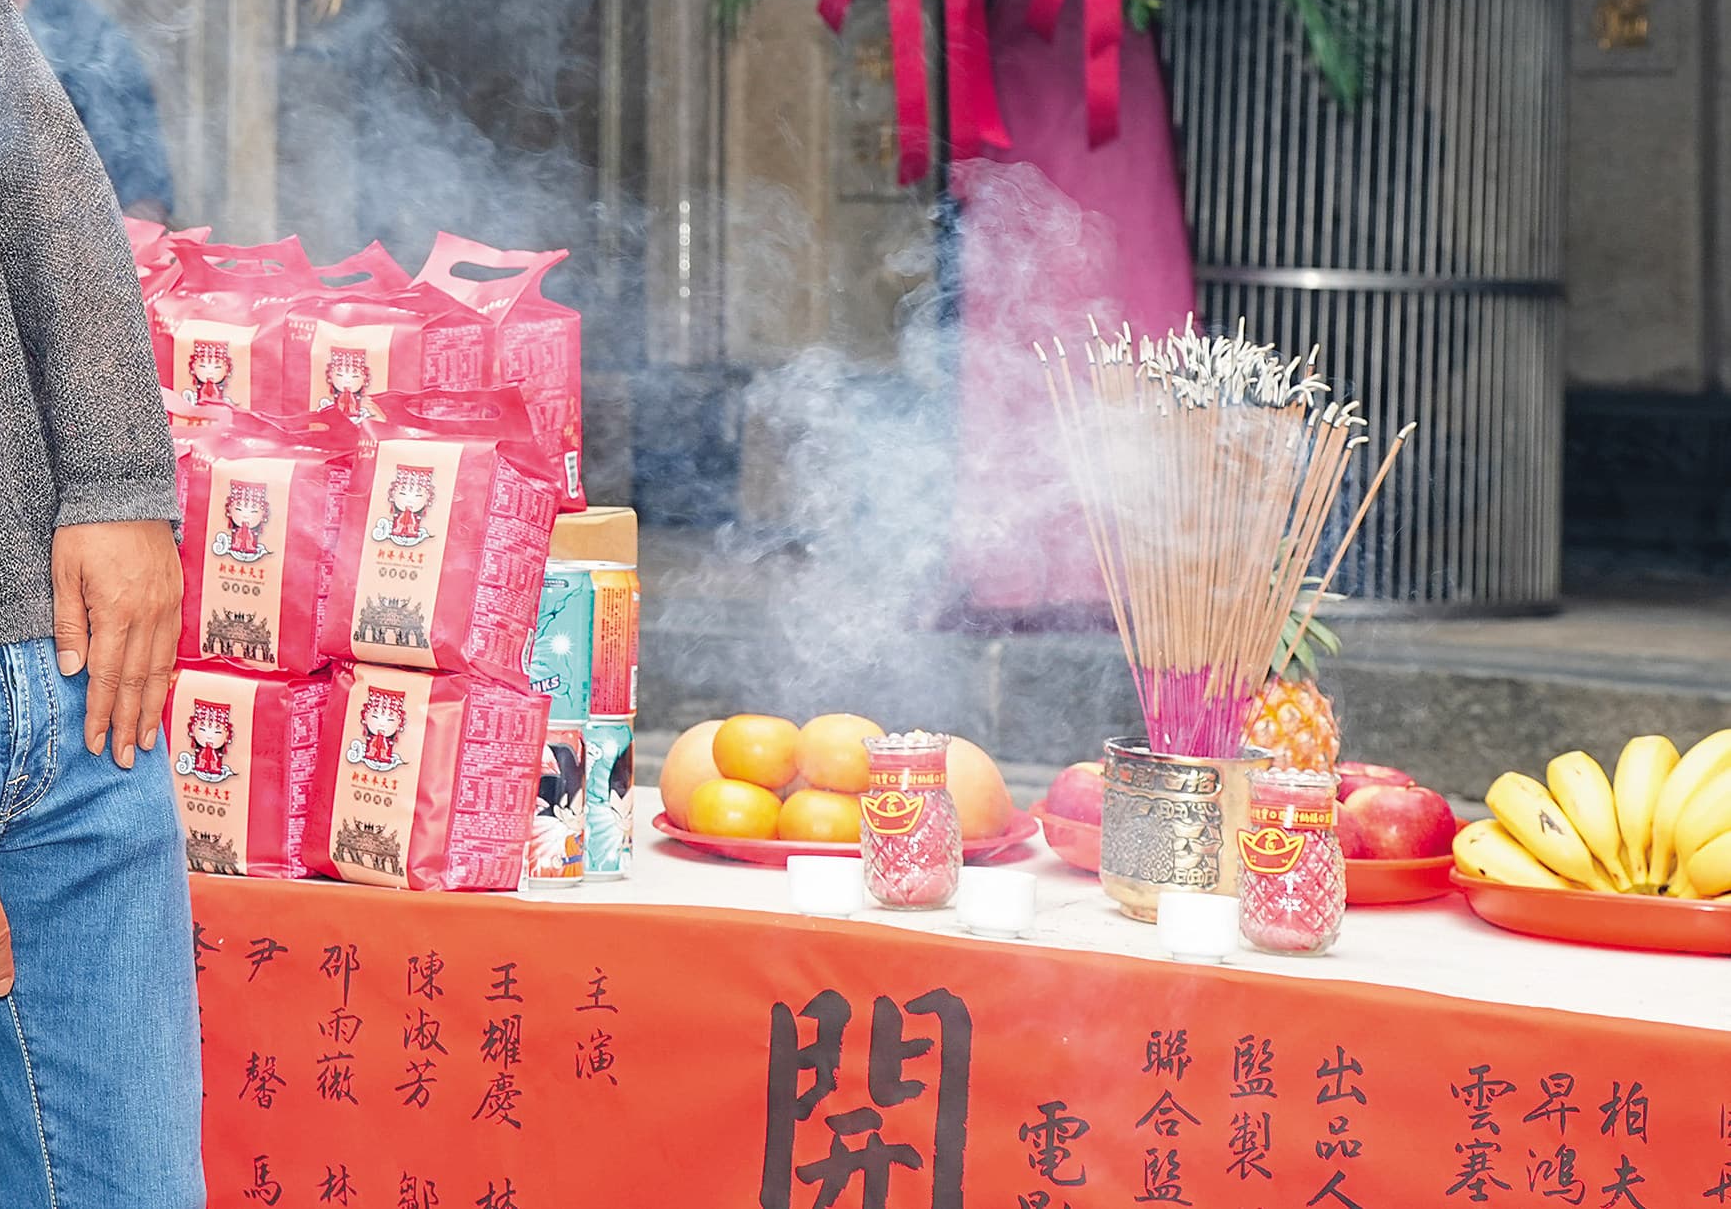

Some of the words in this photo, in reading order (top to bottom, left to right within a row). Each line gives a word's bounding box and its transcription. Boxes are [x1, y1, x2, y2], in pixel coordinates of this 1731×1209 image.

[238, 937, 288, 1109] 尹馨
[316, 943, 364, 1105] 邵雨薇
[395, 949, 450, 1109] 陳淑芳
[471, 962, 525, 1130] 王耀慶
[574, 966, 619, 1086] 主演
[759, 988, 974, 1209] 開
[243, 1154, 283, 1206] 馬
[318, 1164, 358, 1207] 林
[1134, 1029, 1203, 1207] 聯合監
[1225, 1034, 1278, 1181] 監製
[1306, 1045, 1368, 1209] 出品人
[1598, 1080, 1650, 1209] 柏夫
